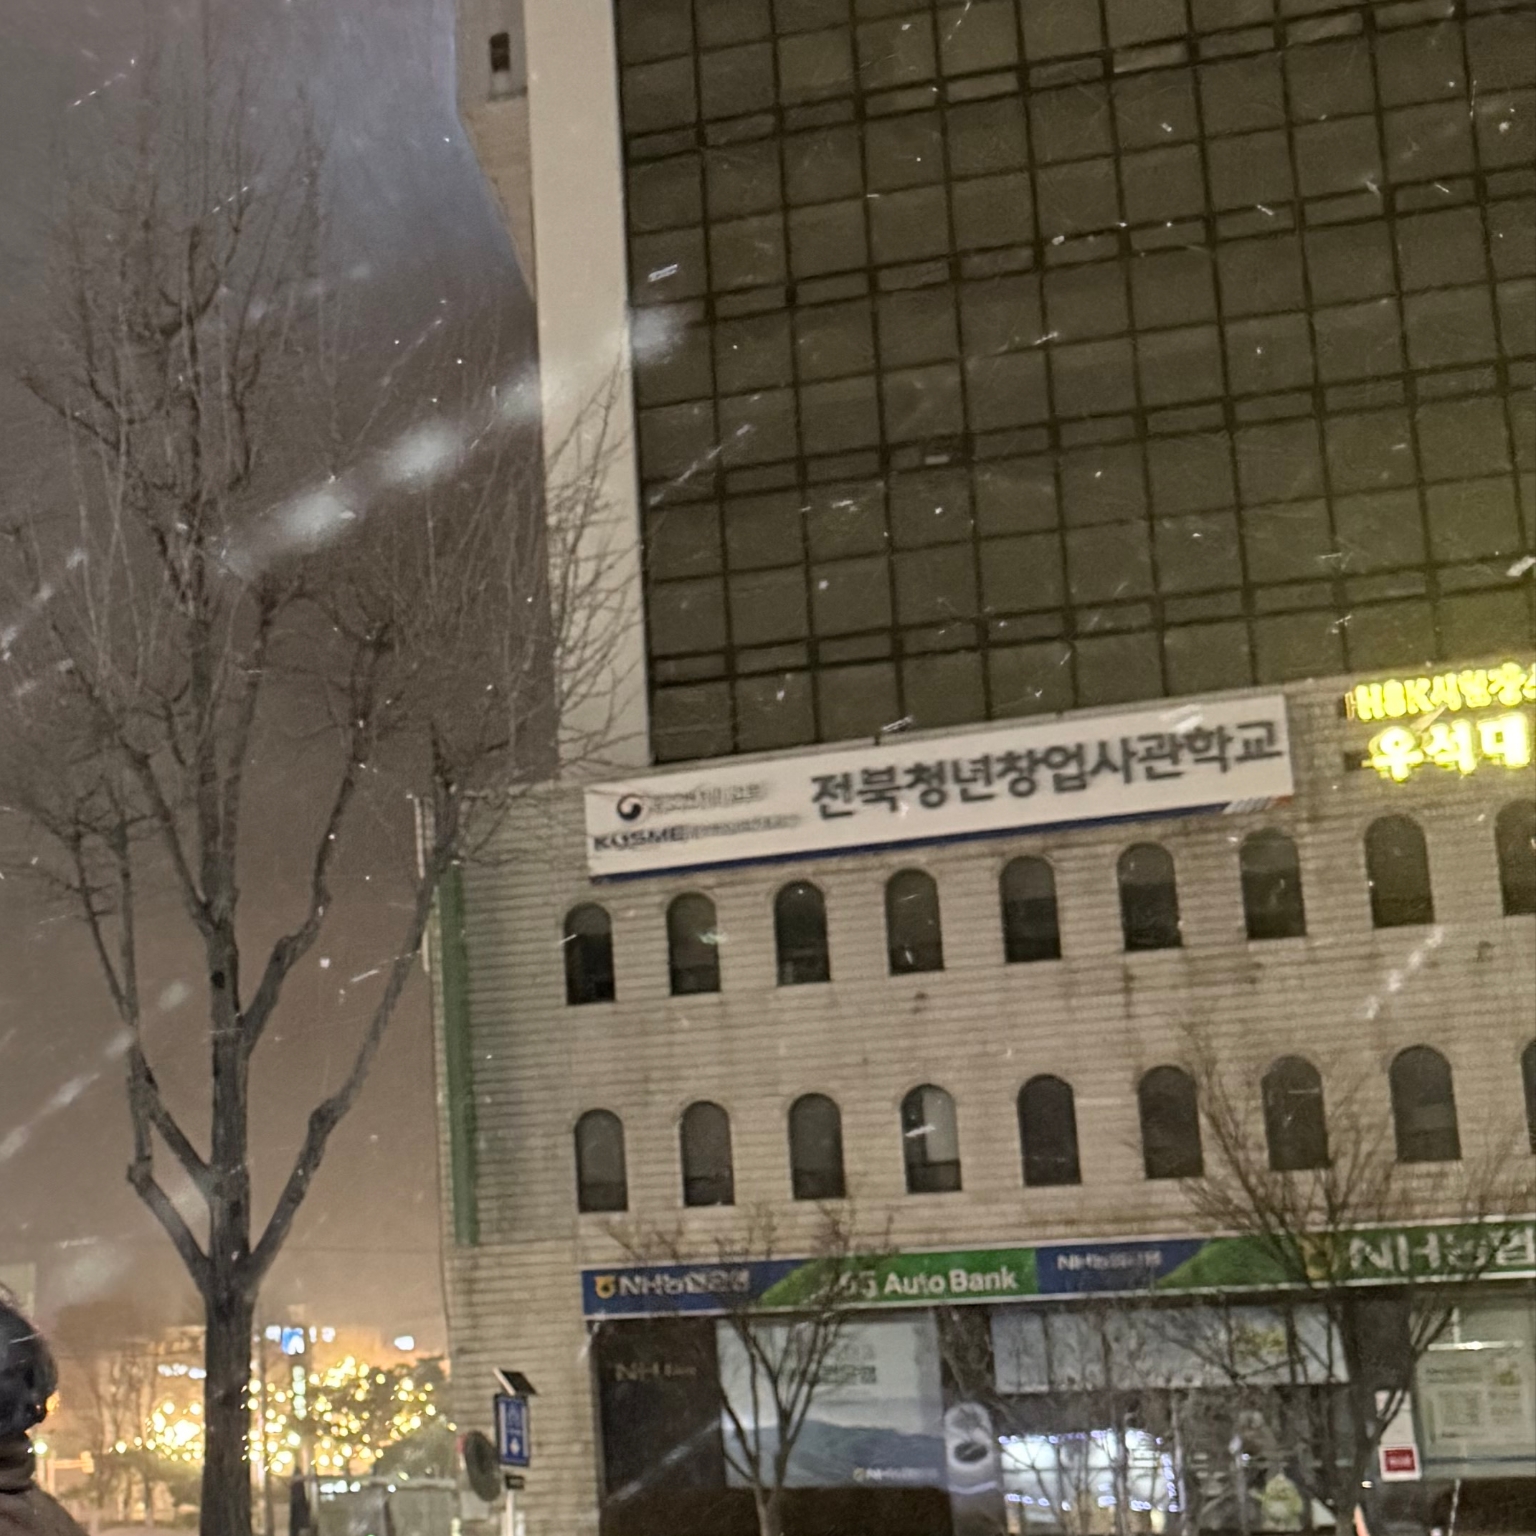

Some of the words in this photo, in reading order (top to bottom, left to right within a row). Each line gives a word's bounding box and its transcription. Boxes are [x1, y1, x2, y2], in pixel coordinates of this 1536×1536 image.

[810, 720, 1284, 819] 전북청년창업사관학교
[1370, 712, 1531, 782] 우석대
[883, 1271, 946, 1295] Auto
[948, 1264, 1019, 1293] Bank
